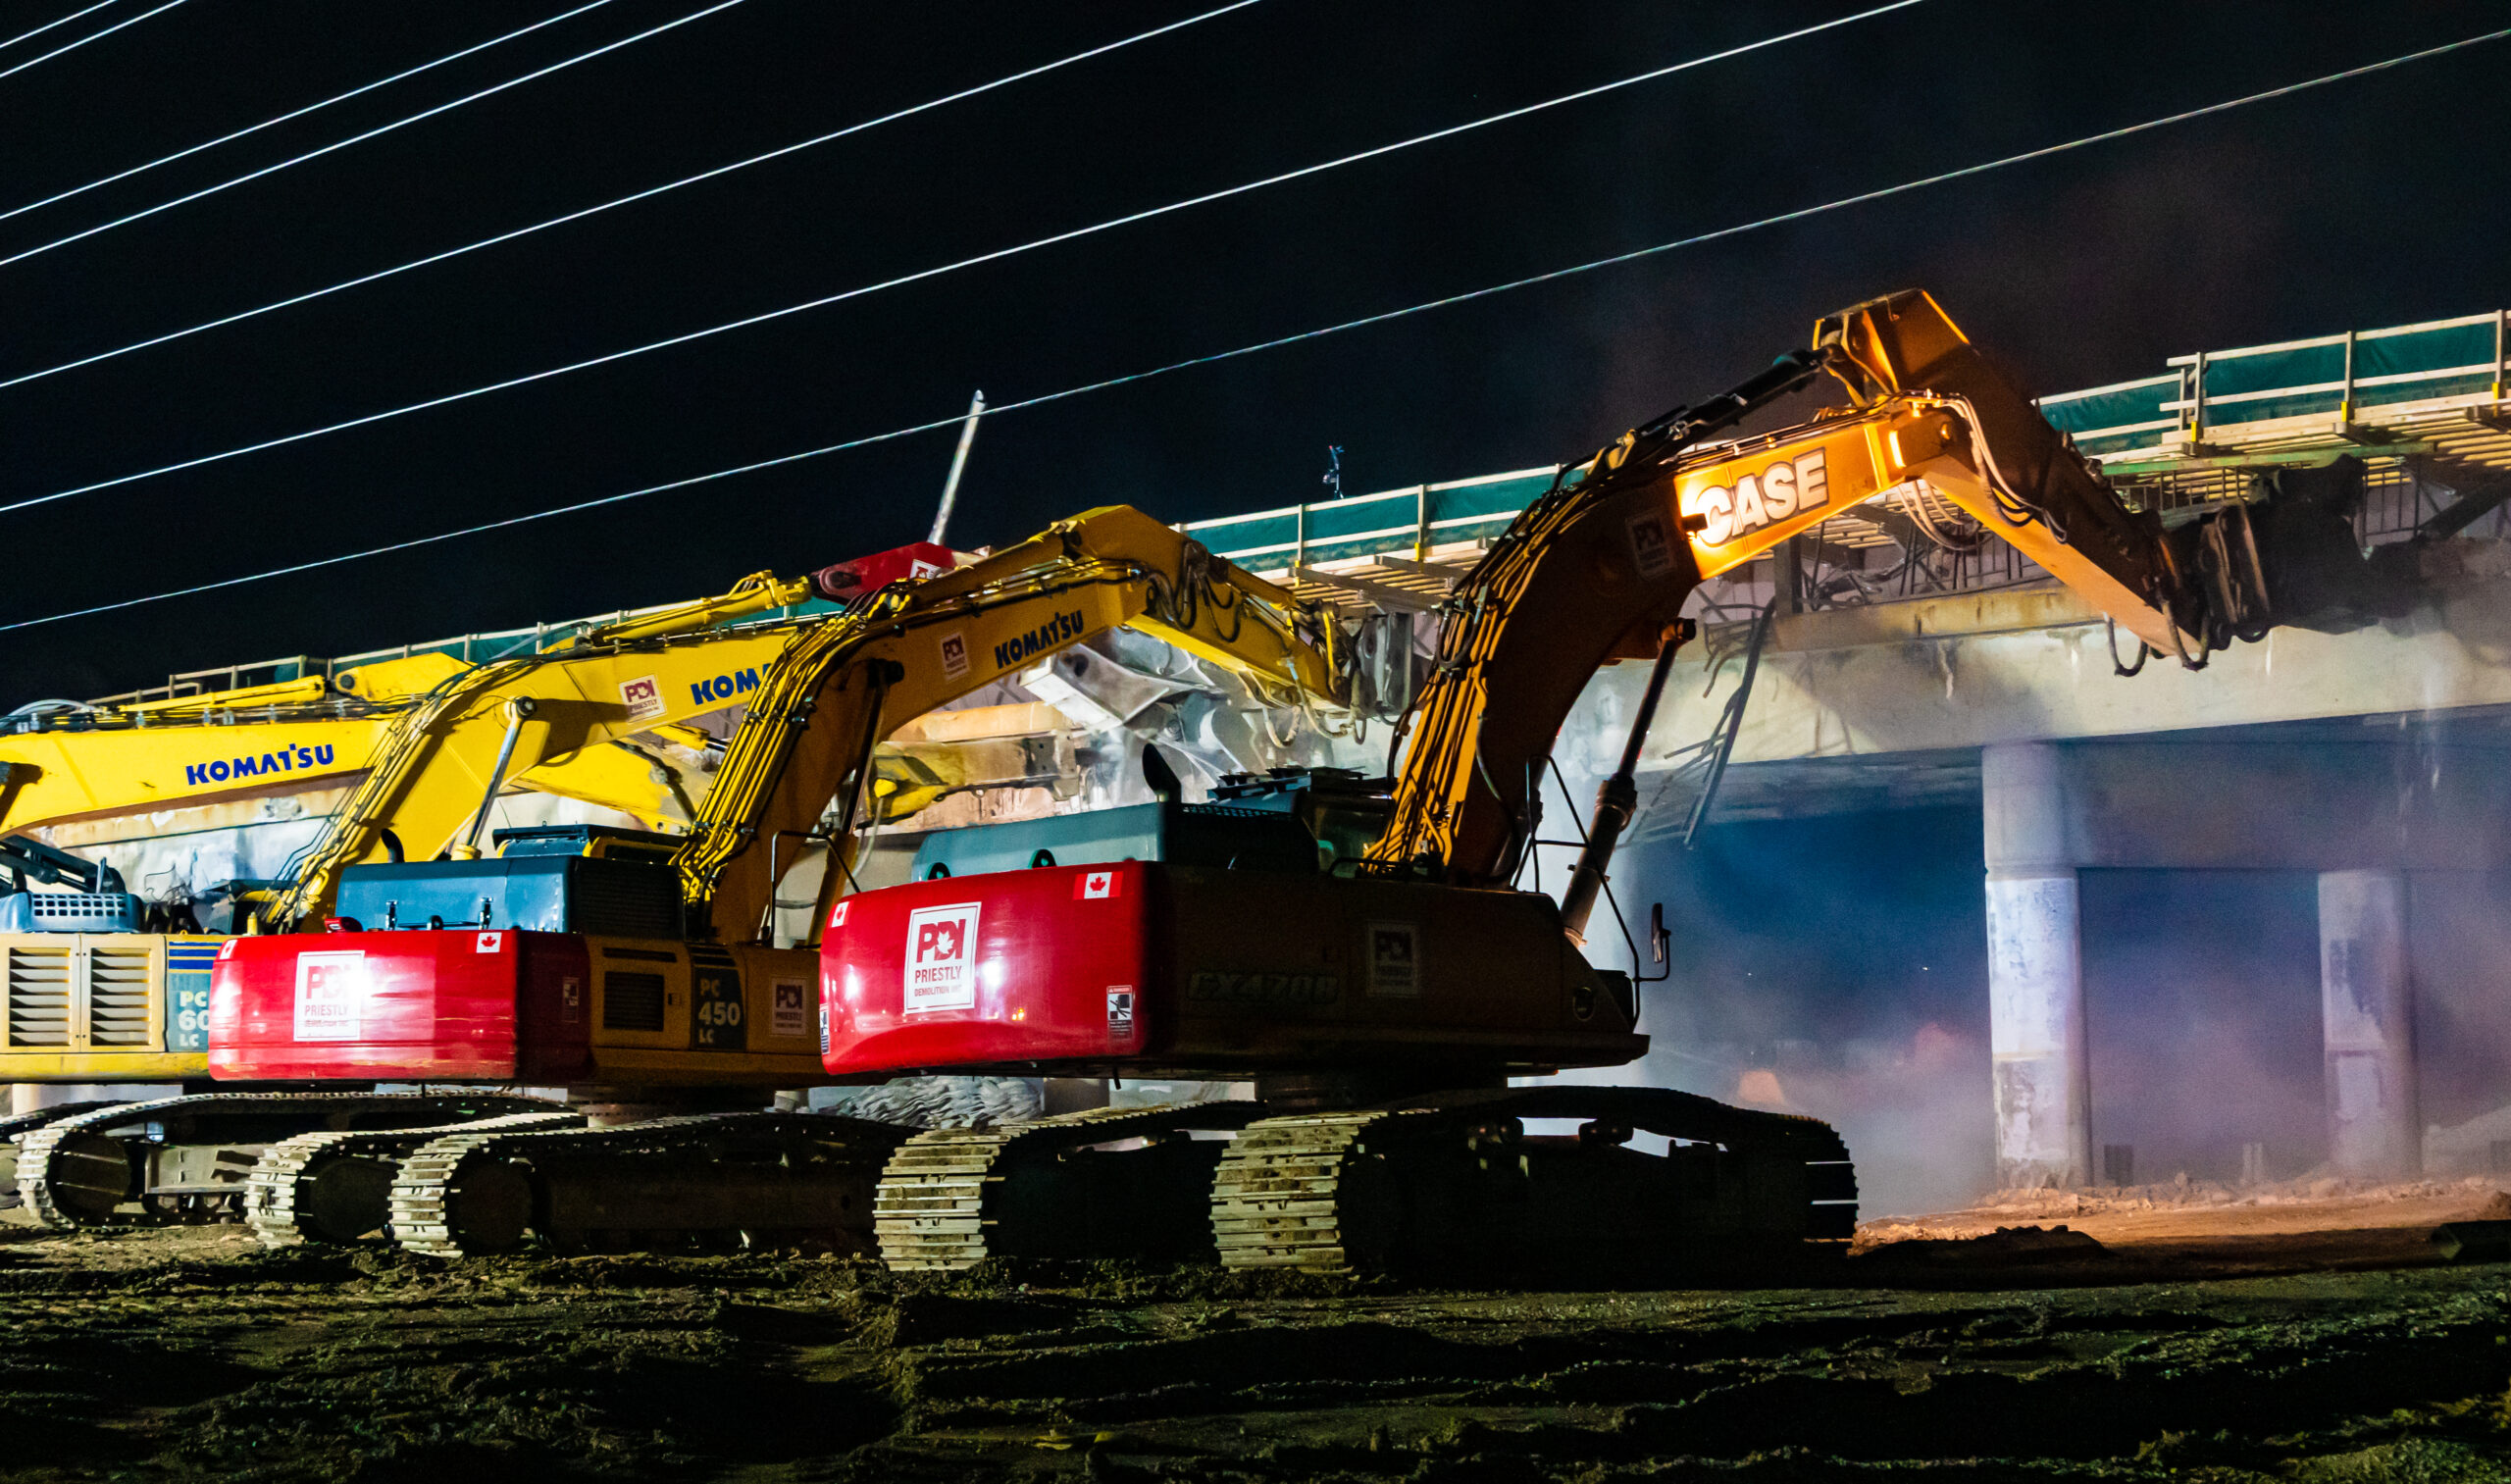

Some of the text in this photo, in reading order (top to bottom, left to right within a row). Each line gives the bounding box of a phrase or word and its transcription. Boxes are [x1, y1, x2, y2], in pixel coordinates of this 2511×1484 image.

[1696, 446, 1830, 547] CASE
[995, 610, 1084, 669] KOMATSU
[624, 680, 656, 703] PDI
[185, 743, 334, 786] KOMATSU
[916, 919, 967, 963] PDI
[915, 965, 963, 984] PRIESTLY
[179, 990, 208, 1007] PC
[699, 978, 721, 998] PC
[776, 985, 803, 1009] PDI
[304, 1003, 349, 1017] PRIESTLY
[697, 1001, 742, 1027] 450
[179, 1033, 200, 1047] LC
[698, 1027, 715, 1044] LC
